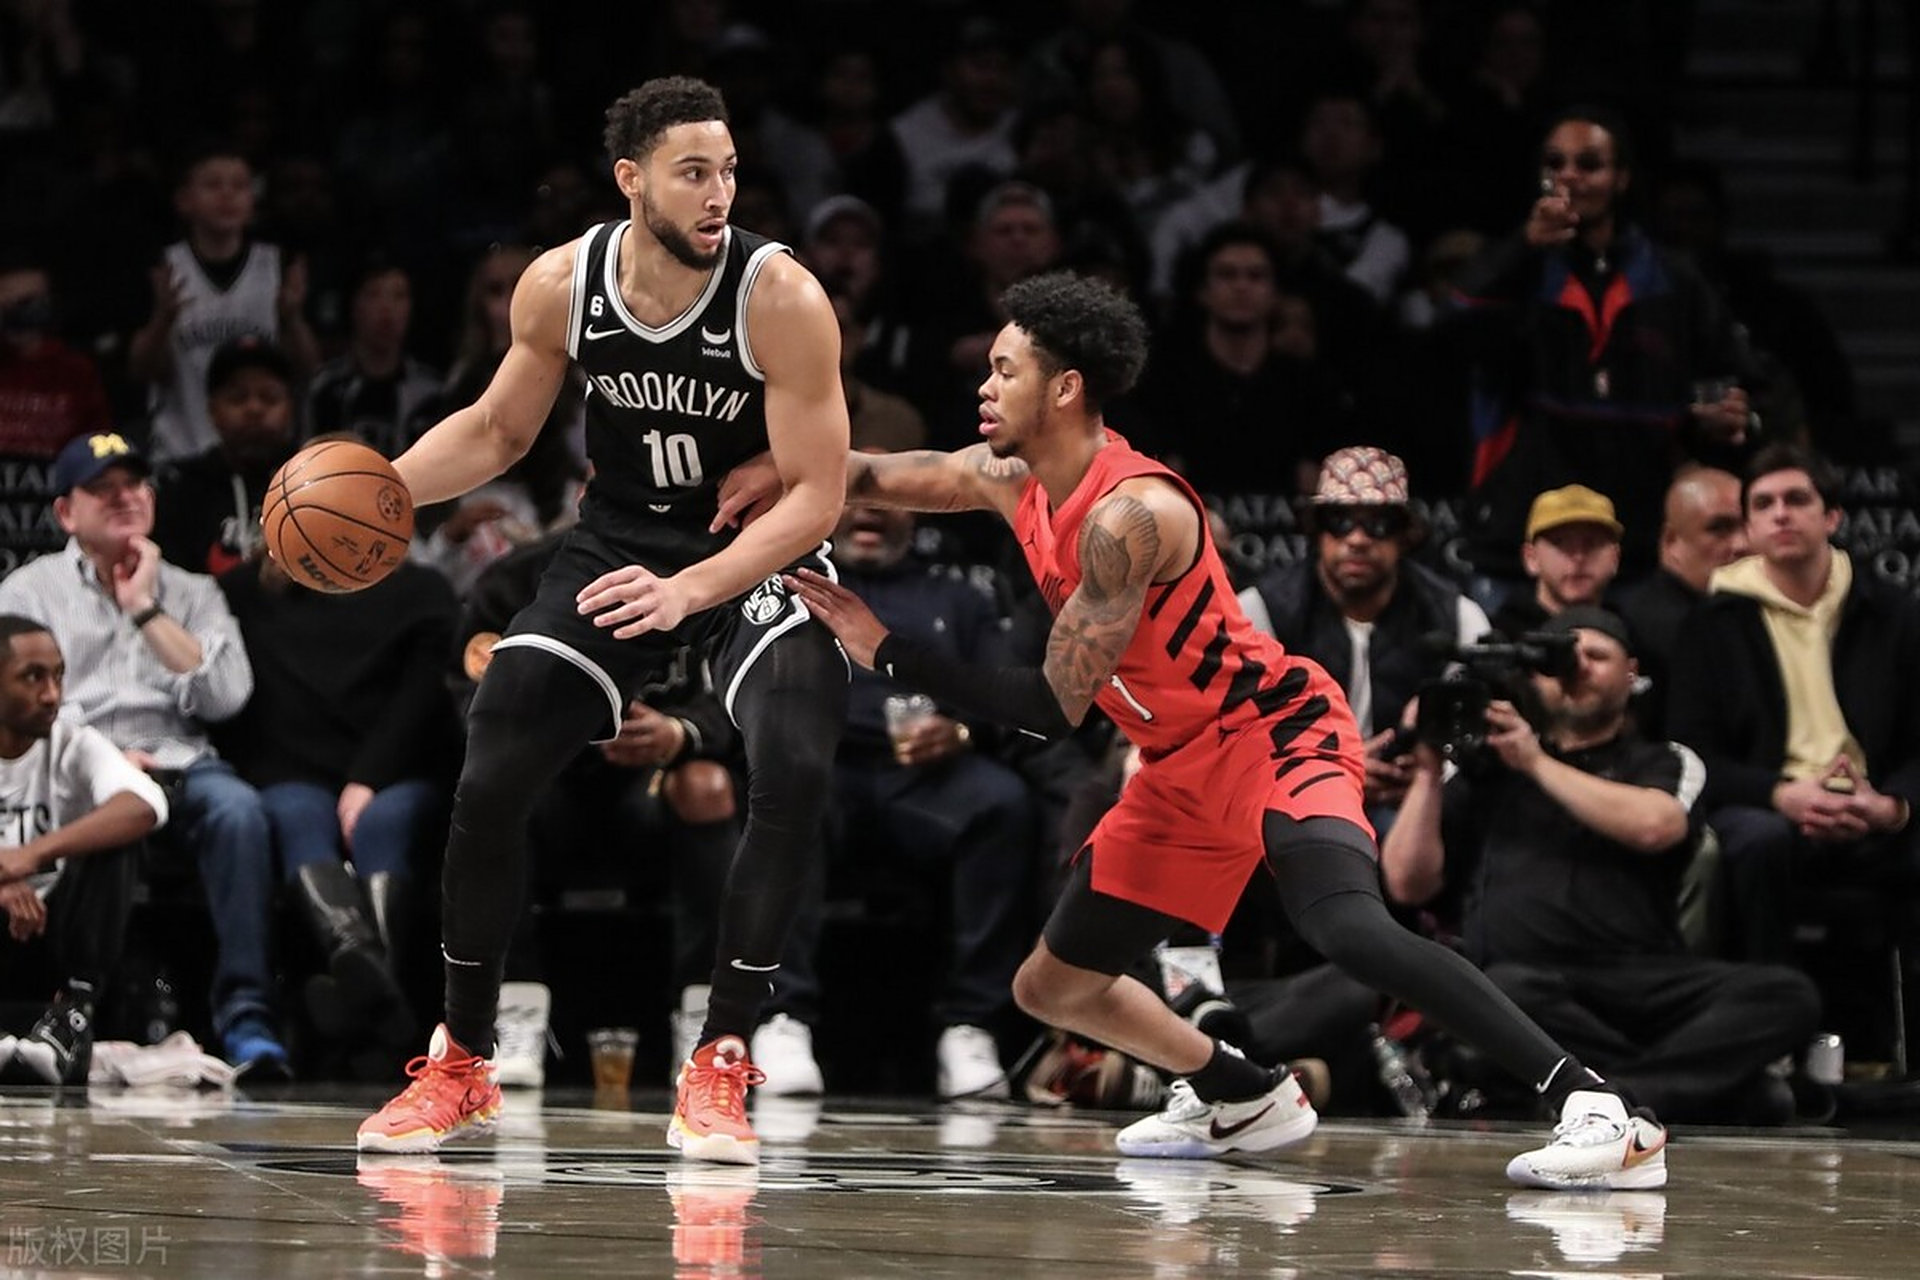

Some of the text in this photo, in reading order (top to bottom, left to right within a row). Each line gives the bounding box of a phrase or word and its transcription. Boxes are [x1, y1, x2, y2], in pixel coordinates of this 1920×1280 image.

[590, 295, 604, 317] 6
[642, 428, 704, 488] 10
[743, 572, 786, 618] NETS
